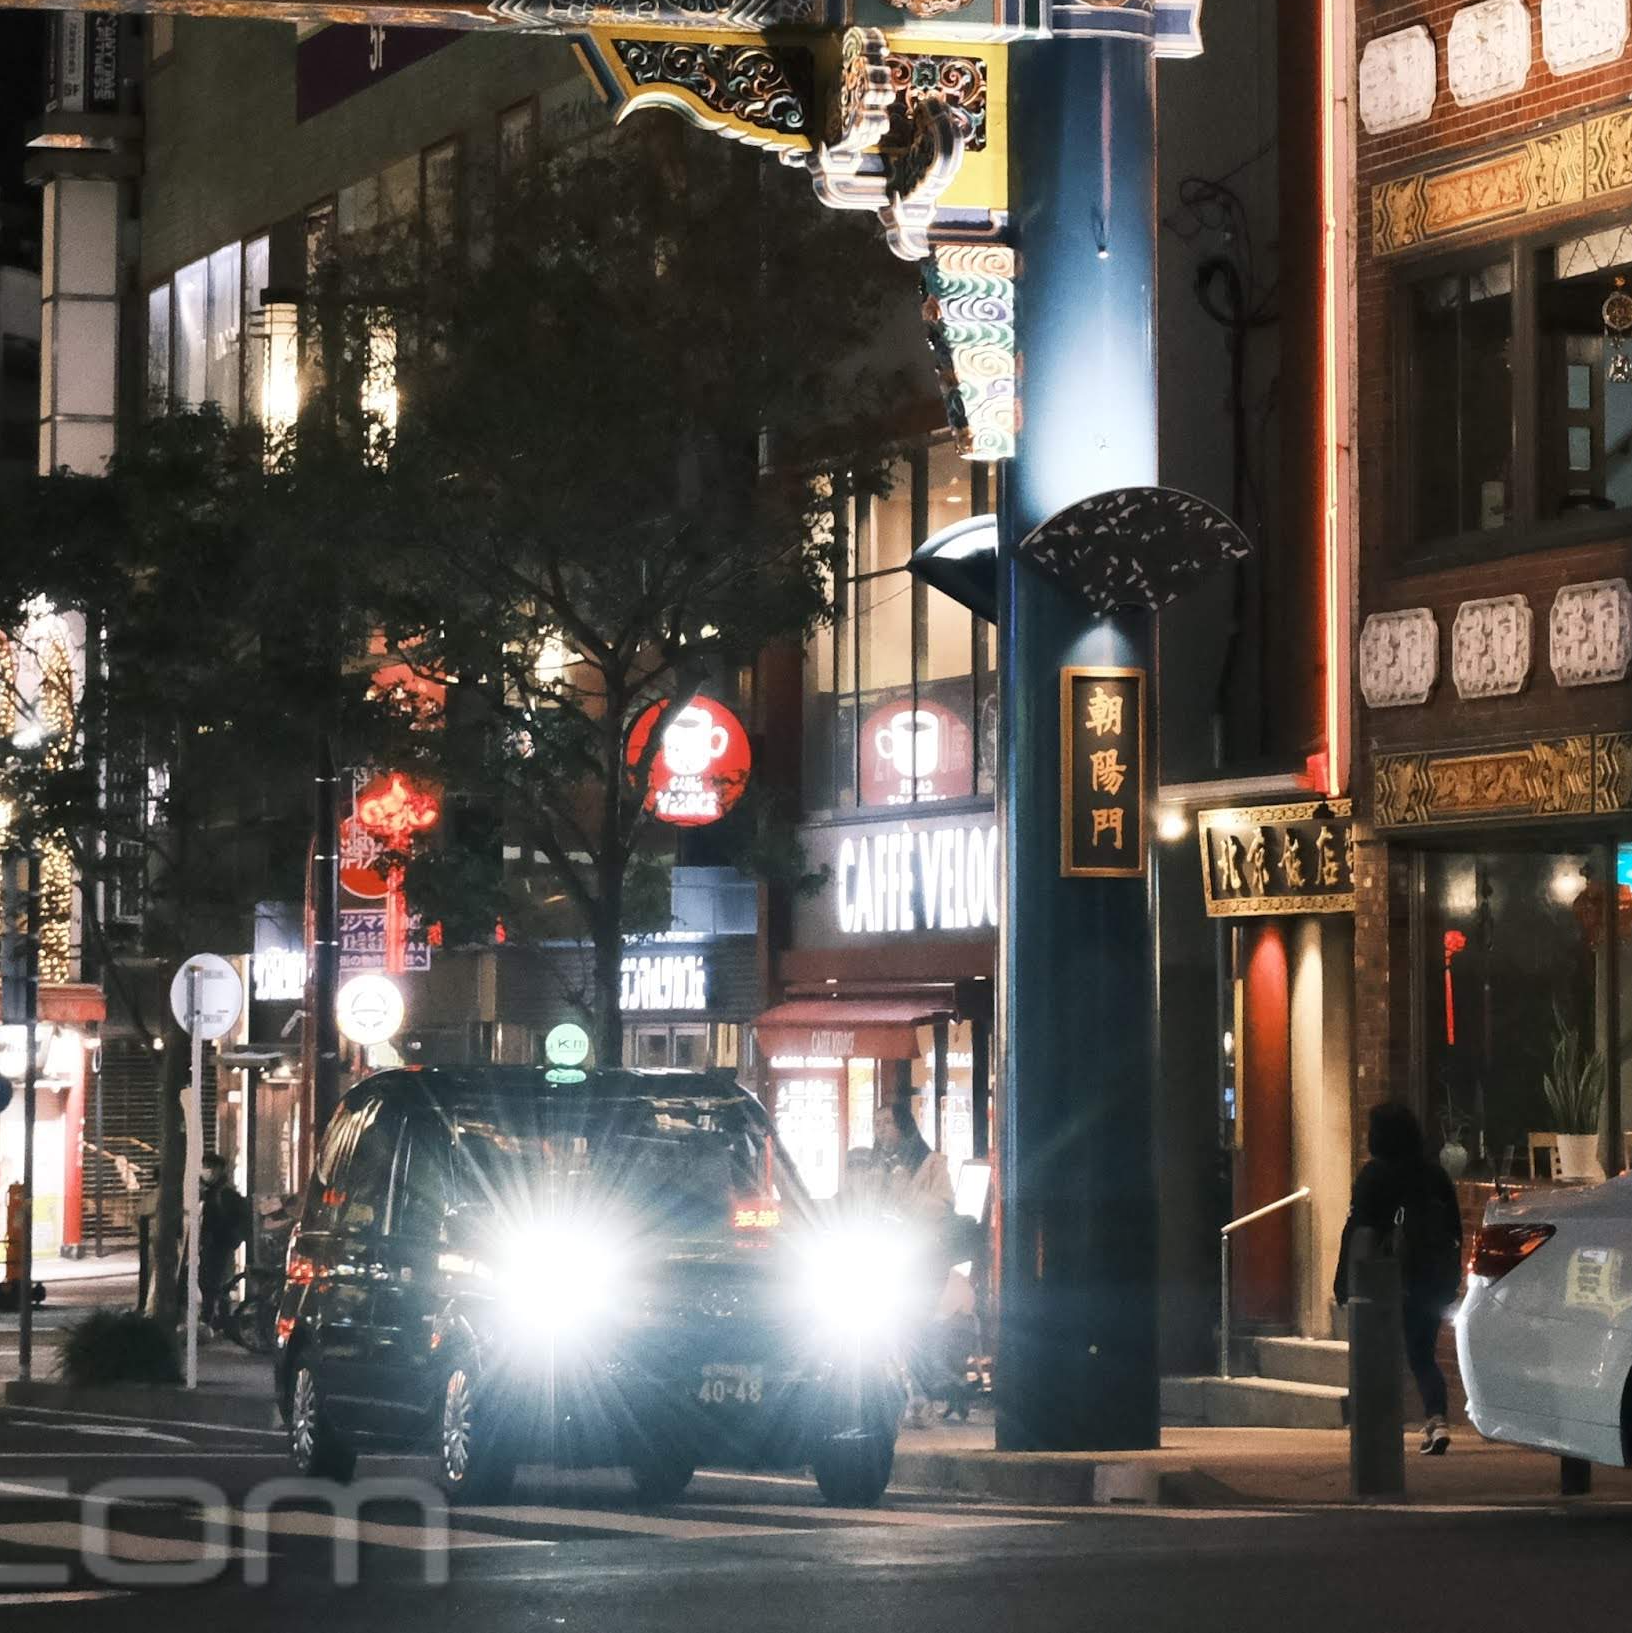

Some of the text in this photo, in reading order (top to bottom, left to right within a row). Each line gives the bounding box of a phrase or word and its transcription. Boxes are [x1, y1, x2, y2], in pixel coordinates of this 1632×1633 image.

[1085, 686, 1127, 850] 朝陽門
[919, 823, 998, 930] VELOC
[1217, 824, 1355, 895] 北京飯店
[698, 1380, 762, 1404] 40-48
